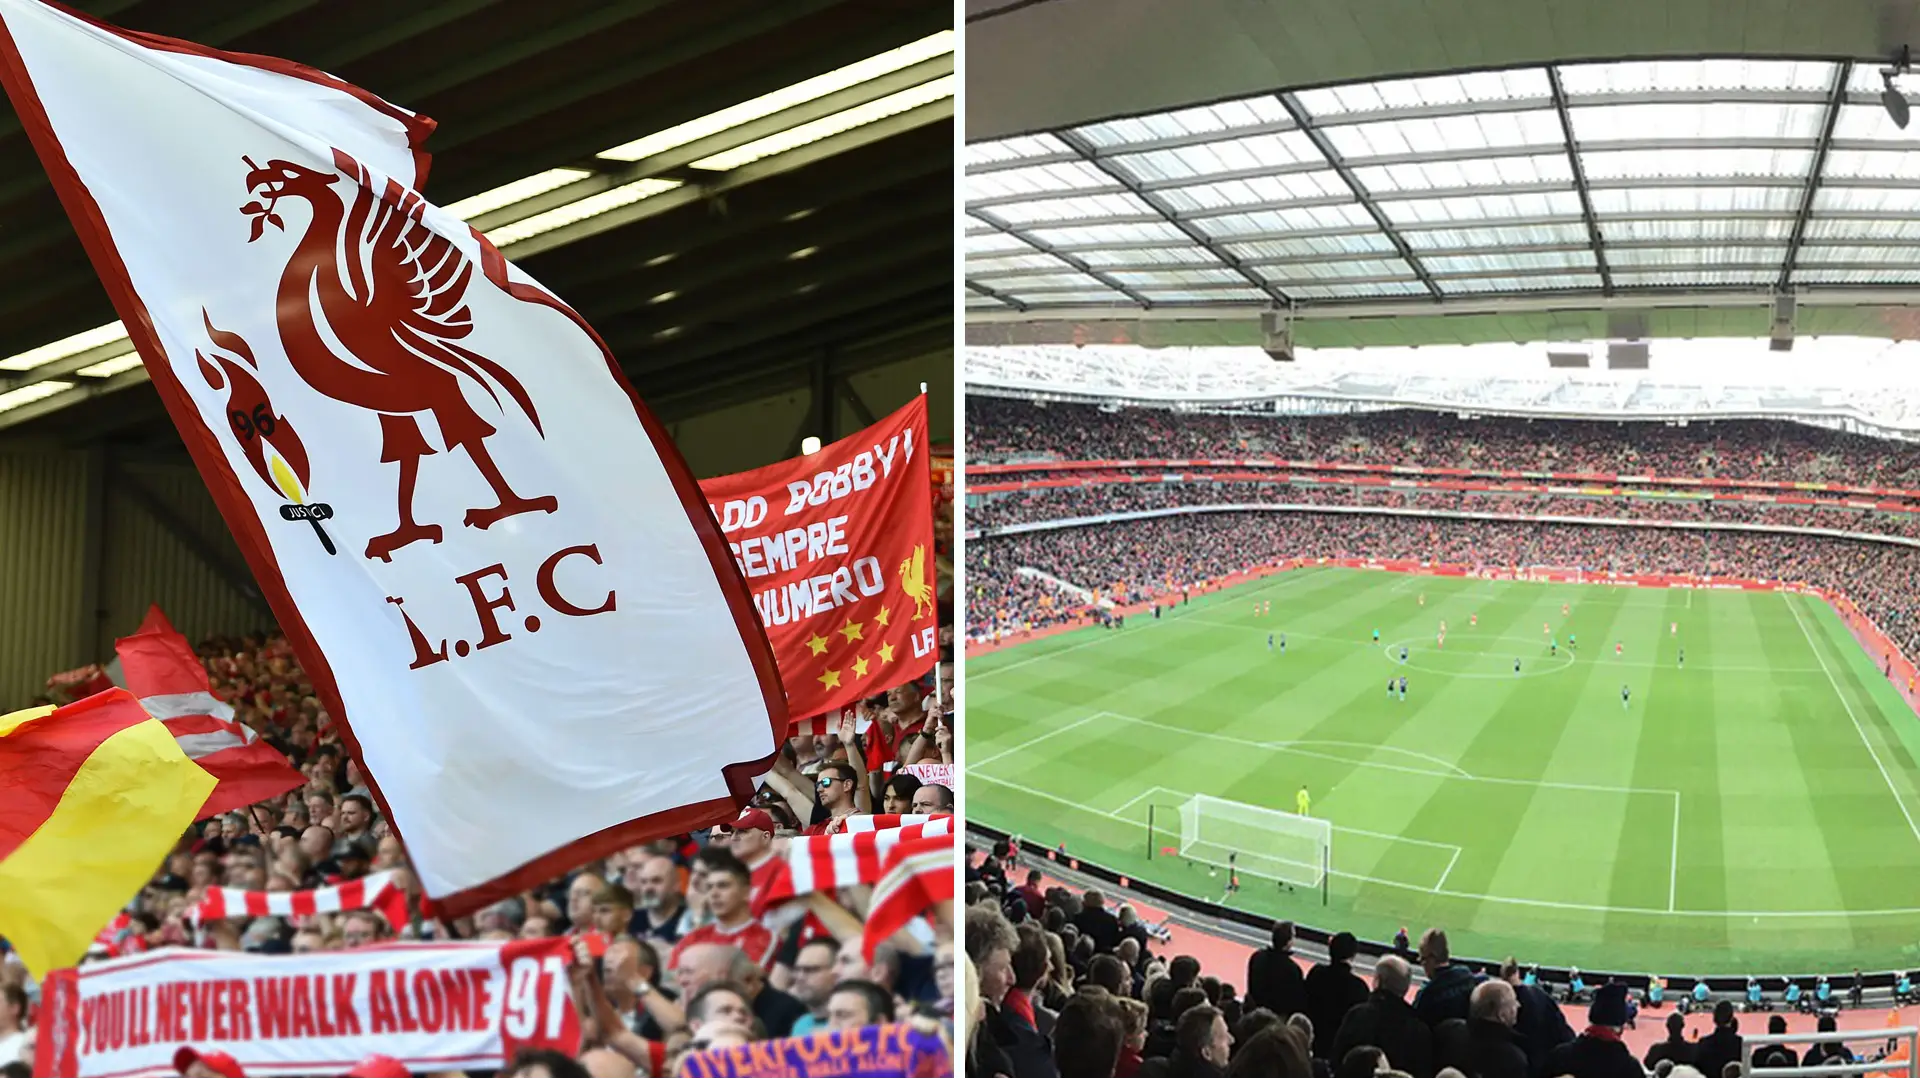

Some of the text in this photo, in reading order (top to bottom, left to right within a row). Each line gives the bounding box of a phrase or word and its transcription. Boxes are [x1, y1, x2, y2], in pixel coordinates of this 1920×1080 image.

[231, 402, 276, 441] 96
[154, 978, 252, 1042] NEVER
[254, 973, 362, 1039] WALK
[369, 968, 493, 1035] ALONE
